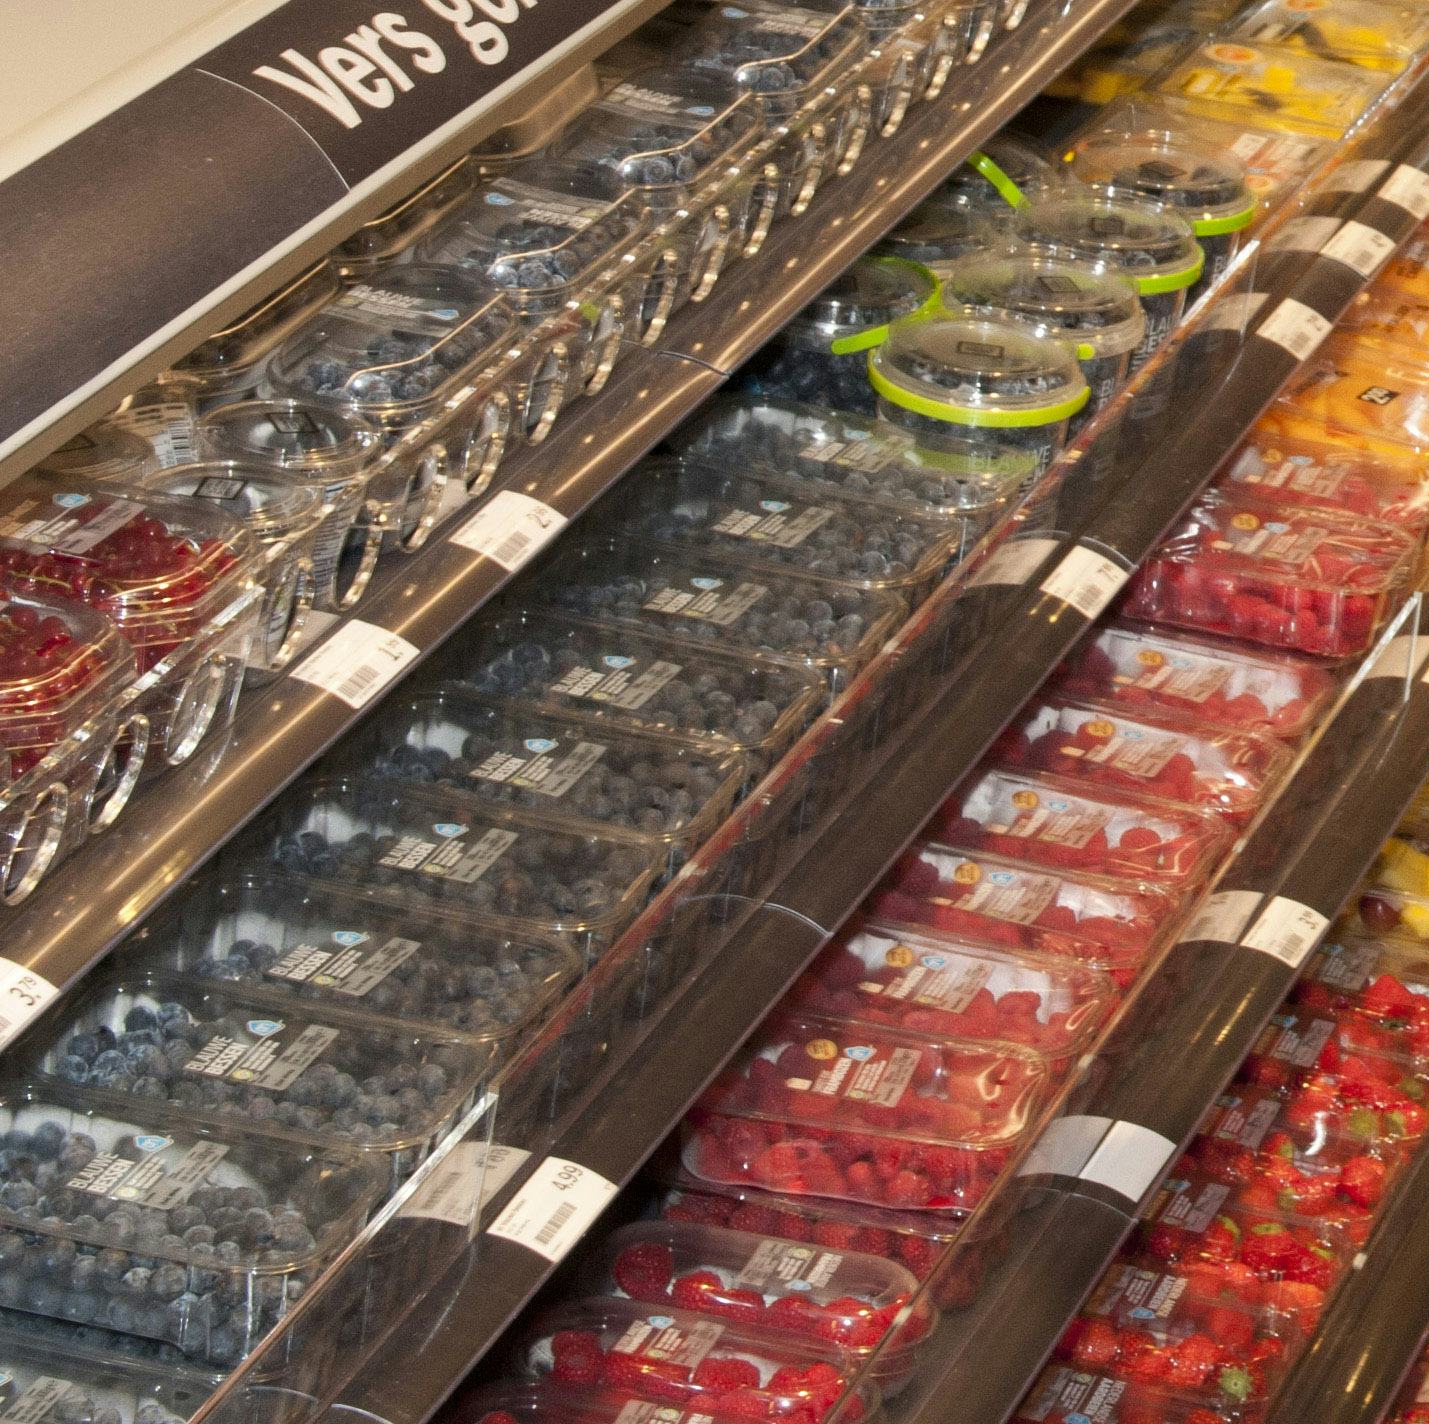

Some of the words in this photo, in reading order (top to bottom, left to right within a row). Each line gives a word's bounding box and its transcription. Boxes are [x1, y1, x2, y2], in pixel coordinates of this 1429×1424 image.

[253, 12, 446, 129] Vers
[10, 975, 40, 1008] 3.79
[184, 1035, 233, 1071] BLAUWE
[205, 1042, 248, 1075] BESSEN
[66, 1152, 118, 1189] BLAUWE
[87, 1159, 135, 1194] BESSEN
[551, 1164, 584, 1192] 4.99
